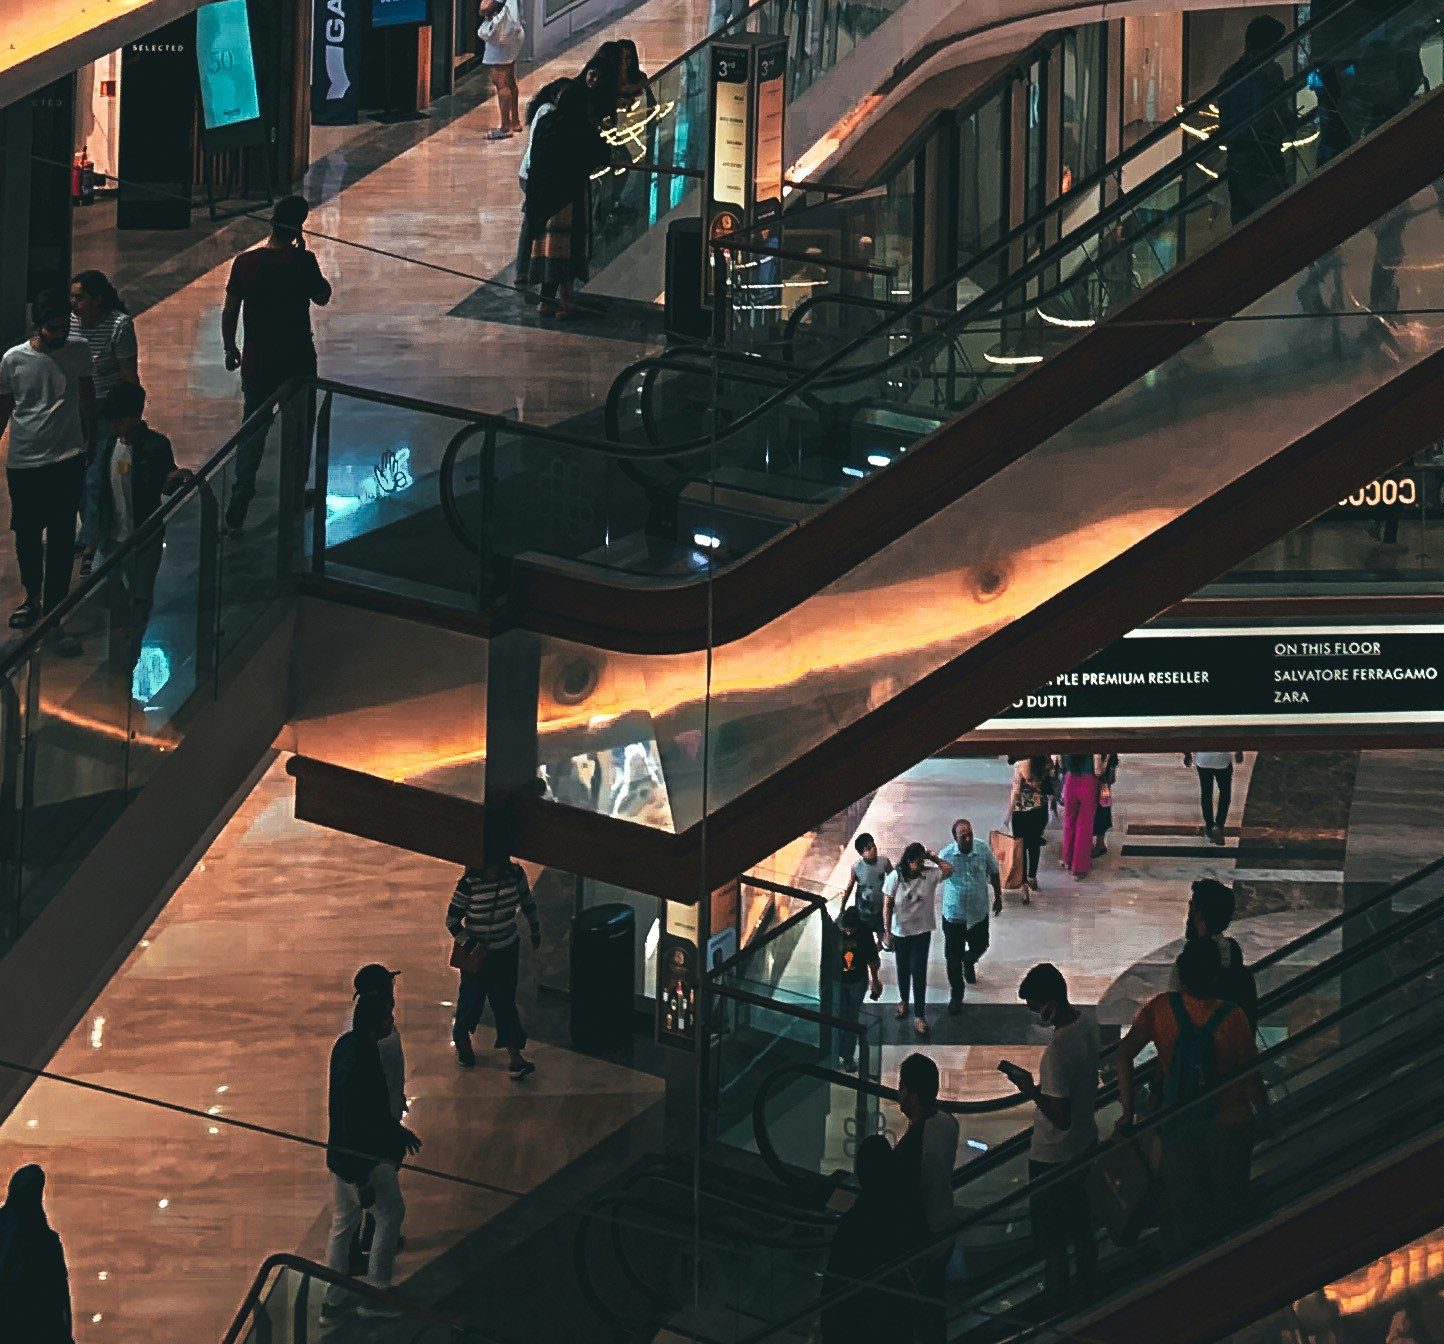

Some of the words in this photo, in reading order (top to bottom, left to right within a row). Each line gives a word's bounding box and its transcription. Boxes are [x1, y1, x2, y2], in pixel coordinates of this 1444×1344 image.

[133, 44, 183, 52] SELECTED
[1274, 643, 1297, 655] ON
[1301, 643, 1331, 655] THIS
[1335, 642, 1381, 654] FLOOR
[1045, 672, 1079, 686] PLE
[1082, 672, 1145, 685] PREMIUM
[1149, 671, 1209, 684] RESELLER
[1274, 669, 1349, 682] SALVATORE
[1353, 667, 1438, 680] FERRAGAMO
[1027, 694, 1067, 708] DUTTI
[1274, 691, 1309, 703] ZARA
